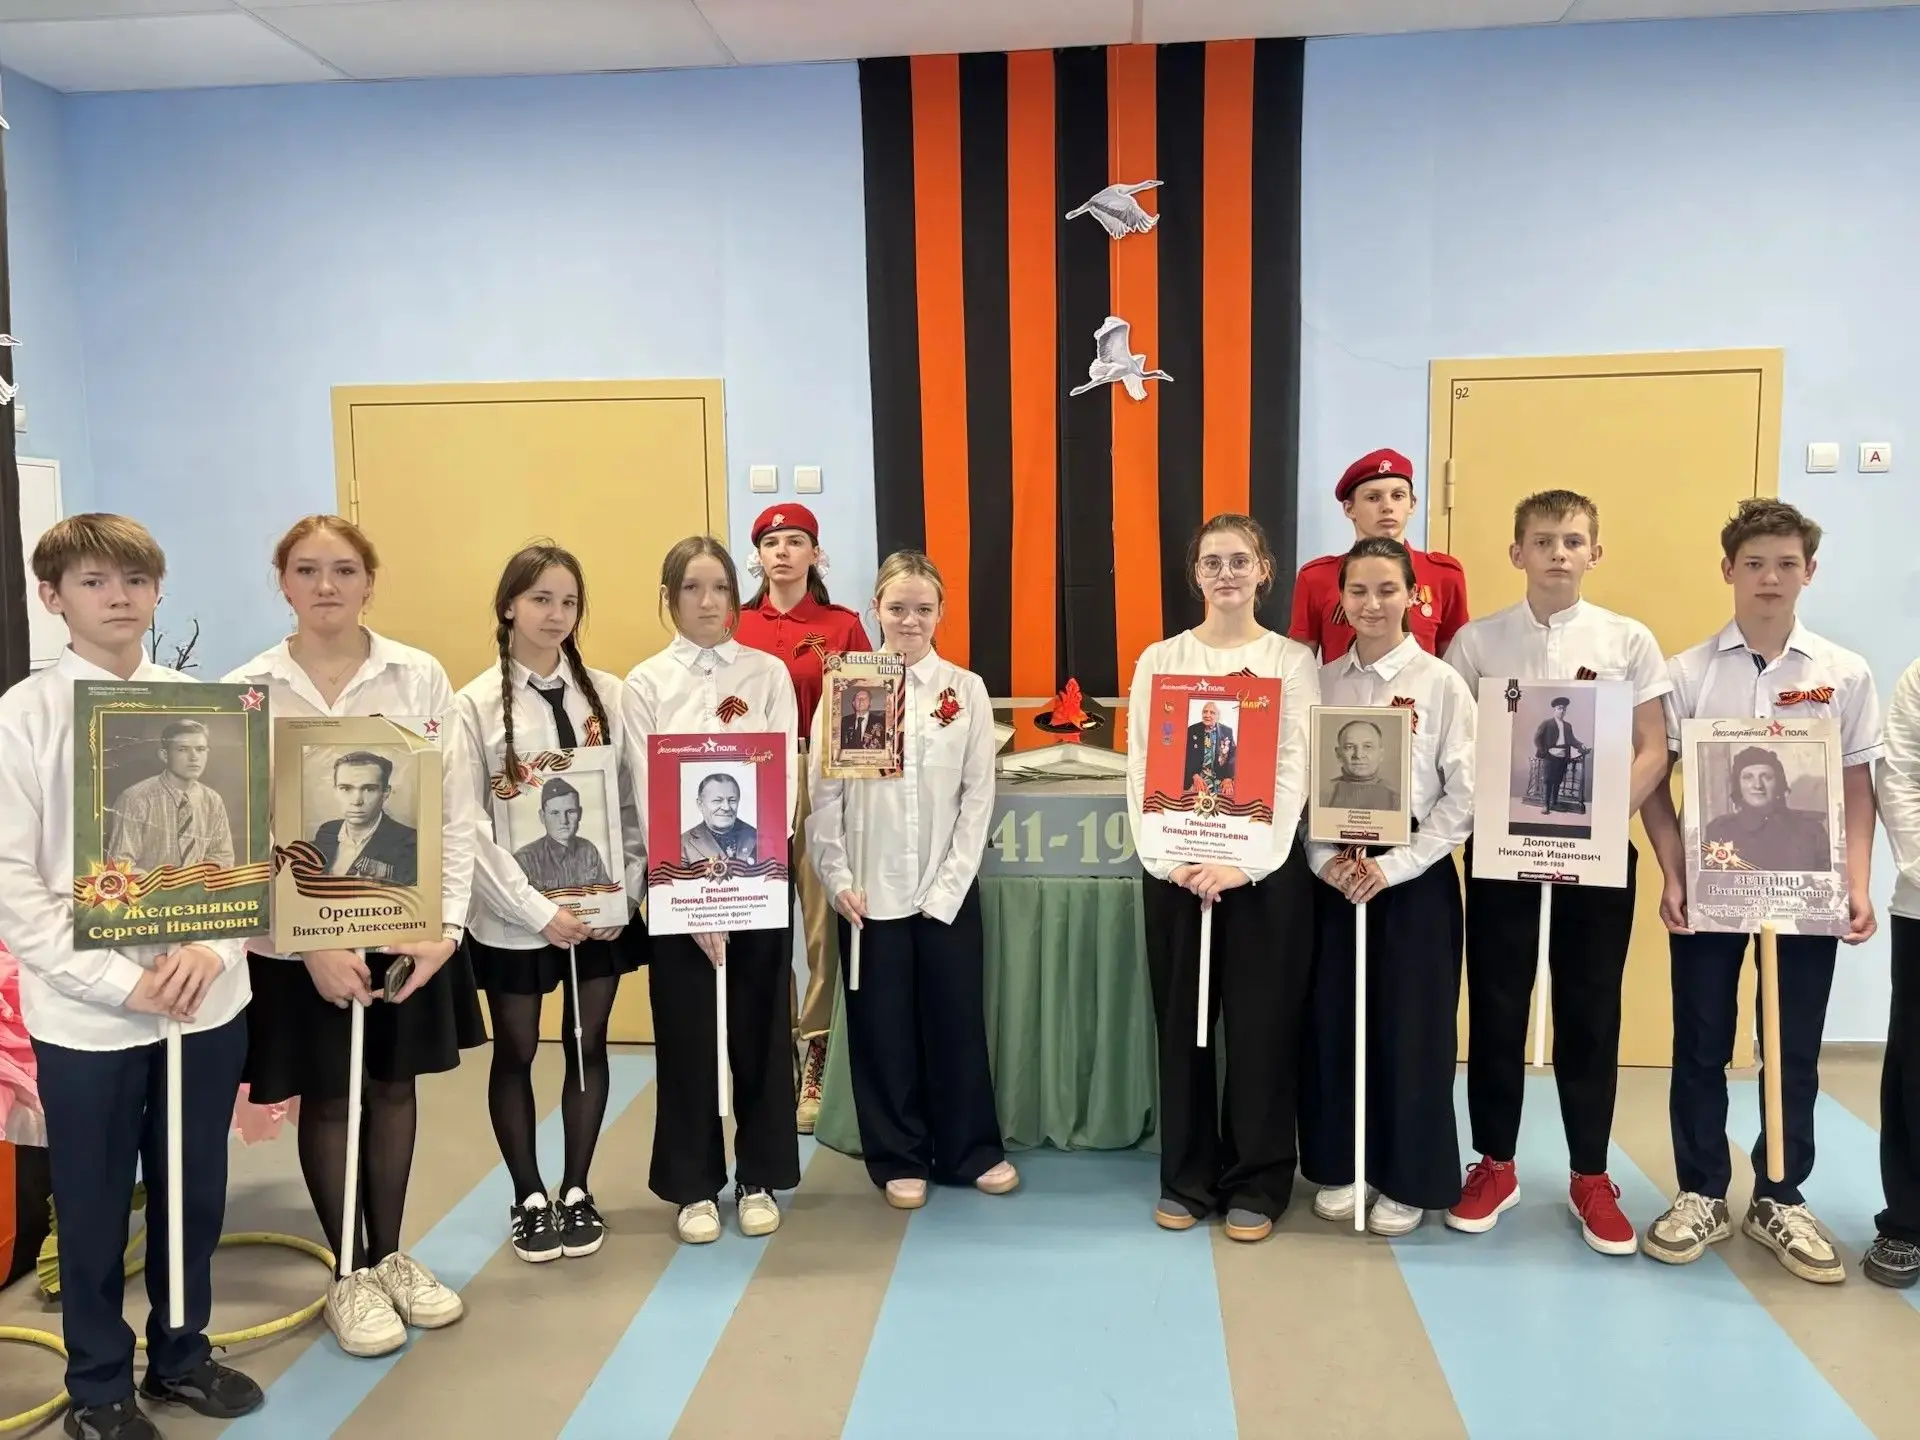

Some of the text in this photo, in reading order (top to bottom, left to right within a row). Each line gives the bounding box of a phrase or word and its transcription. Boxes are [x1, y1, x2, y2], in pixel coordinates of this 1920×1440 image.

[1455, 387, 1469, 400] 92
[879, 665, 904, 675] ПОЛК
[1184, 818, 1227, 829] Ганьшина
[1162, 826, 1249, 841] Клавдия Игнатьевна
[1522, 838, 1576, 849] Долотцев
[1498, 847, 1601, 861] Николай Иванович
[700, 886, 740, 894] Ганьшин
[670, 894, 769, 905] Леонид Валентинович
[123, 899, 260, 920] Железняков
[319, 905, 403, 922] Орешков
[88, 916, 259, 941] Сергей Иванович
[292, 920, 427, 937] Виктор Алексеевич
